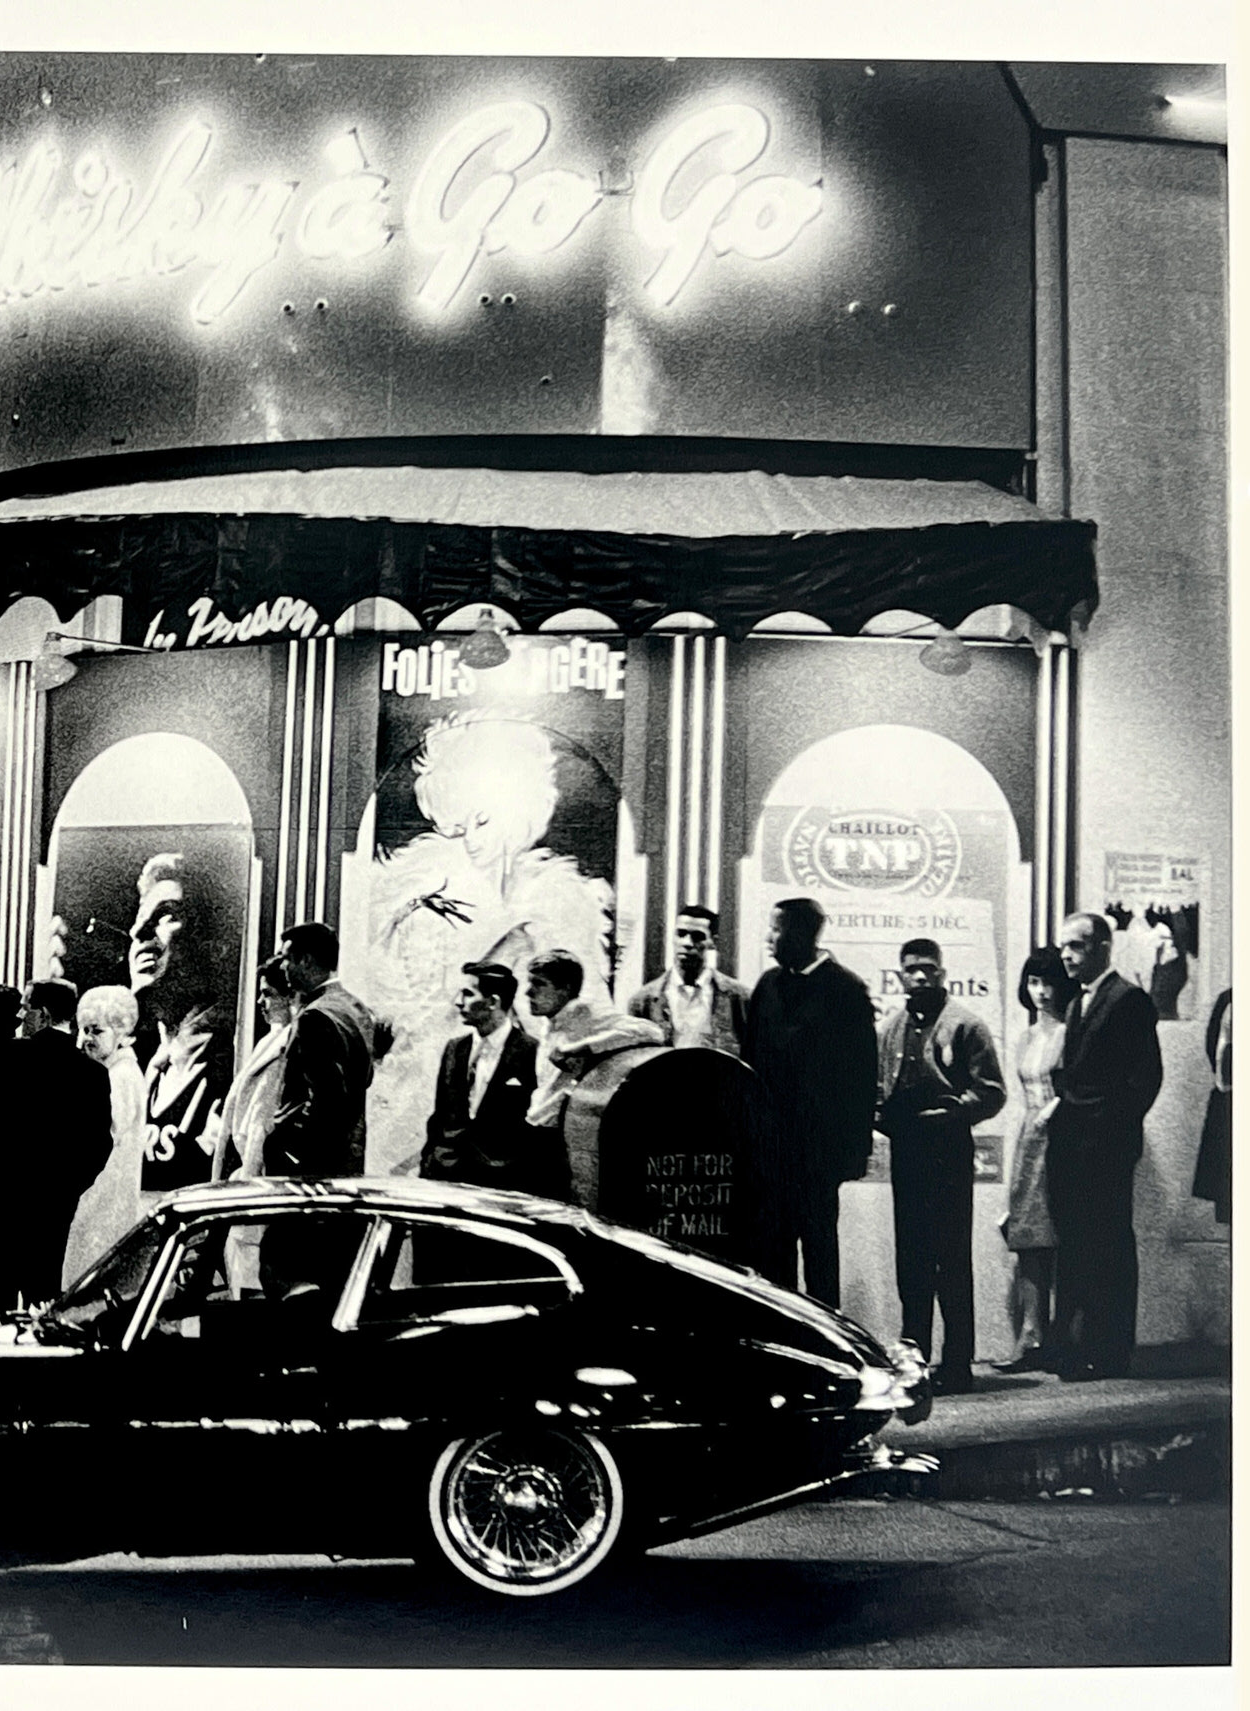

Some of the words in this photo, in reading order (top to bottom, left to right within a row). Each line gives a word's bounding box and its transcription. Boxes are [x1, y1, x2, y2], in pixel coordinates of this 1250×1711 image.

[405, 100, 603, 311] Go
[632, 103, 824, 306] Go
[826, 837, 923, 872] TNP
[826, 913, 906, 930] VERTURE
[647, 1153, 687, 1177] NOT
[693, 1153, 734, 1176] FOR
[681, 1213, 729, 1237] MAIL
